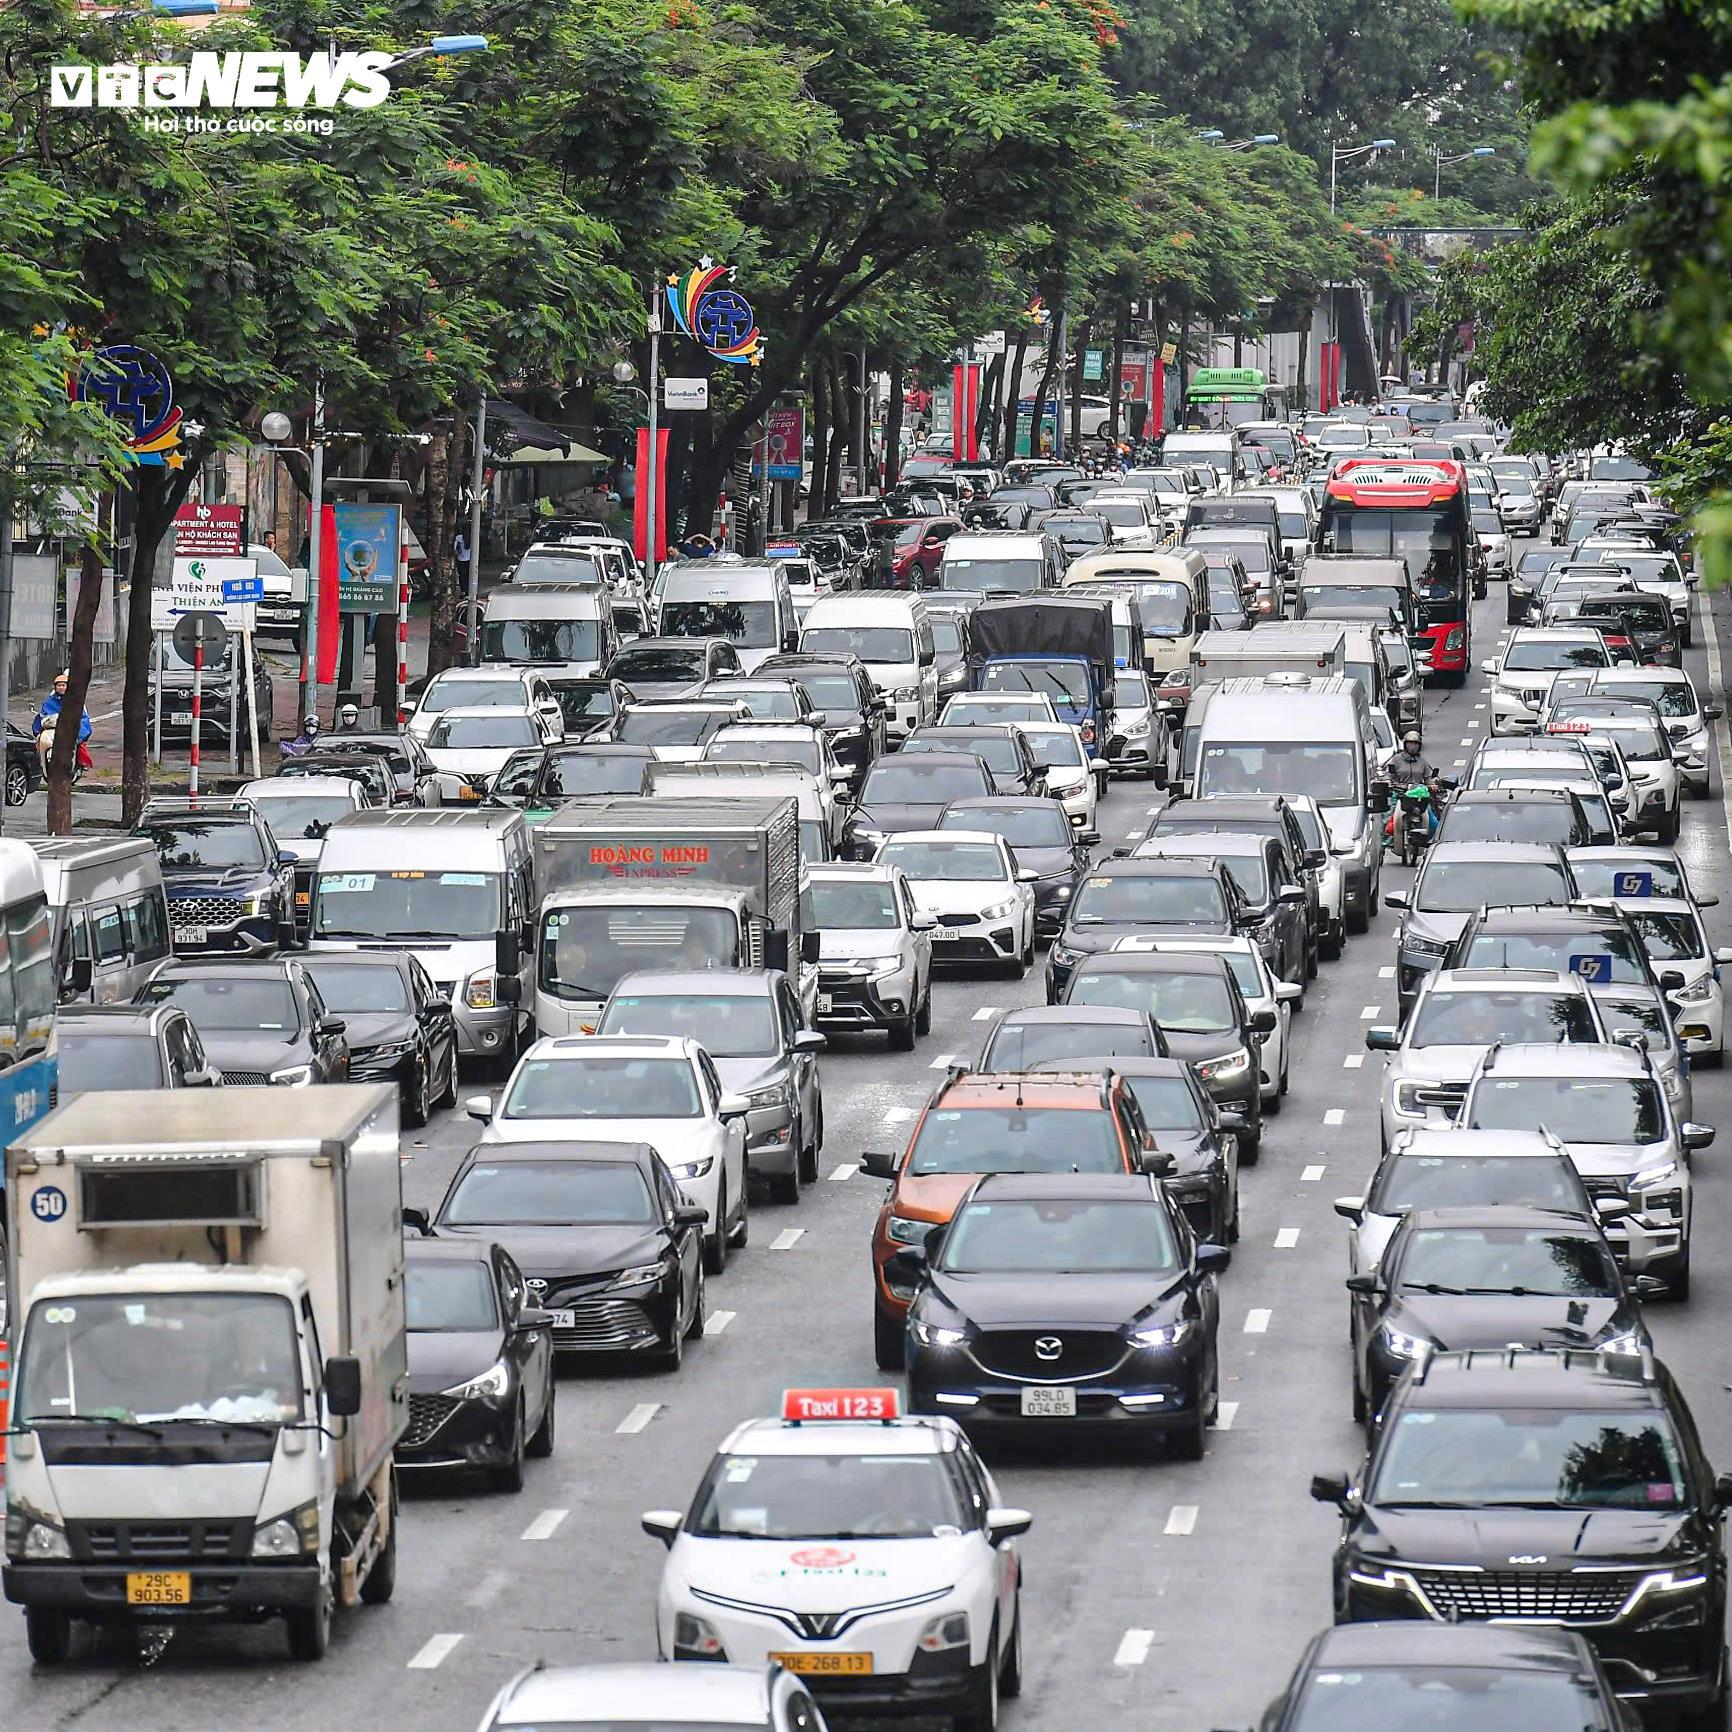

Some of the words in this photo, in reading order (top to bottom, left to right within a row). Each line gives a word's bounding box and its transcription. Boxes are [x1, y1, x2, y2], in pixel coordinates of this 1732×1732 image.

[217, 521, 239, 529] HOTEL
[589, 843, 655, 864] HOÀNG
[661, 847, 710, 864] MINH
[624, 867, 678, 878] EXPRESS
[348, 877, 367, 889] 01
[34, 1192, 64, 1217] 50
[798, 1397, 839, 1417] Taxi
[843, 1397, 884, 1417] 123
[145, 1574, 172, 1588] 29C
